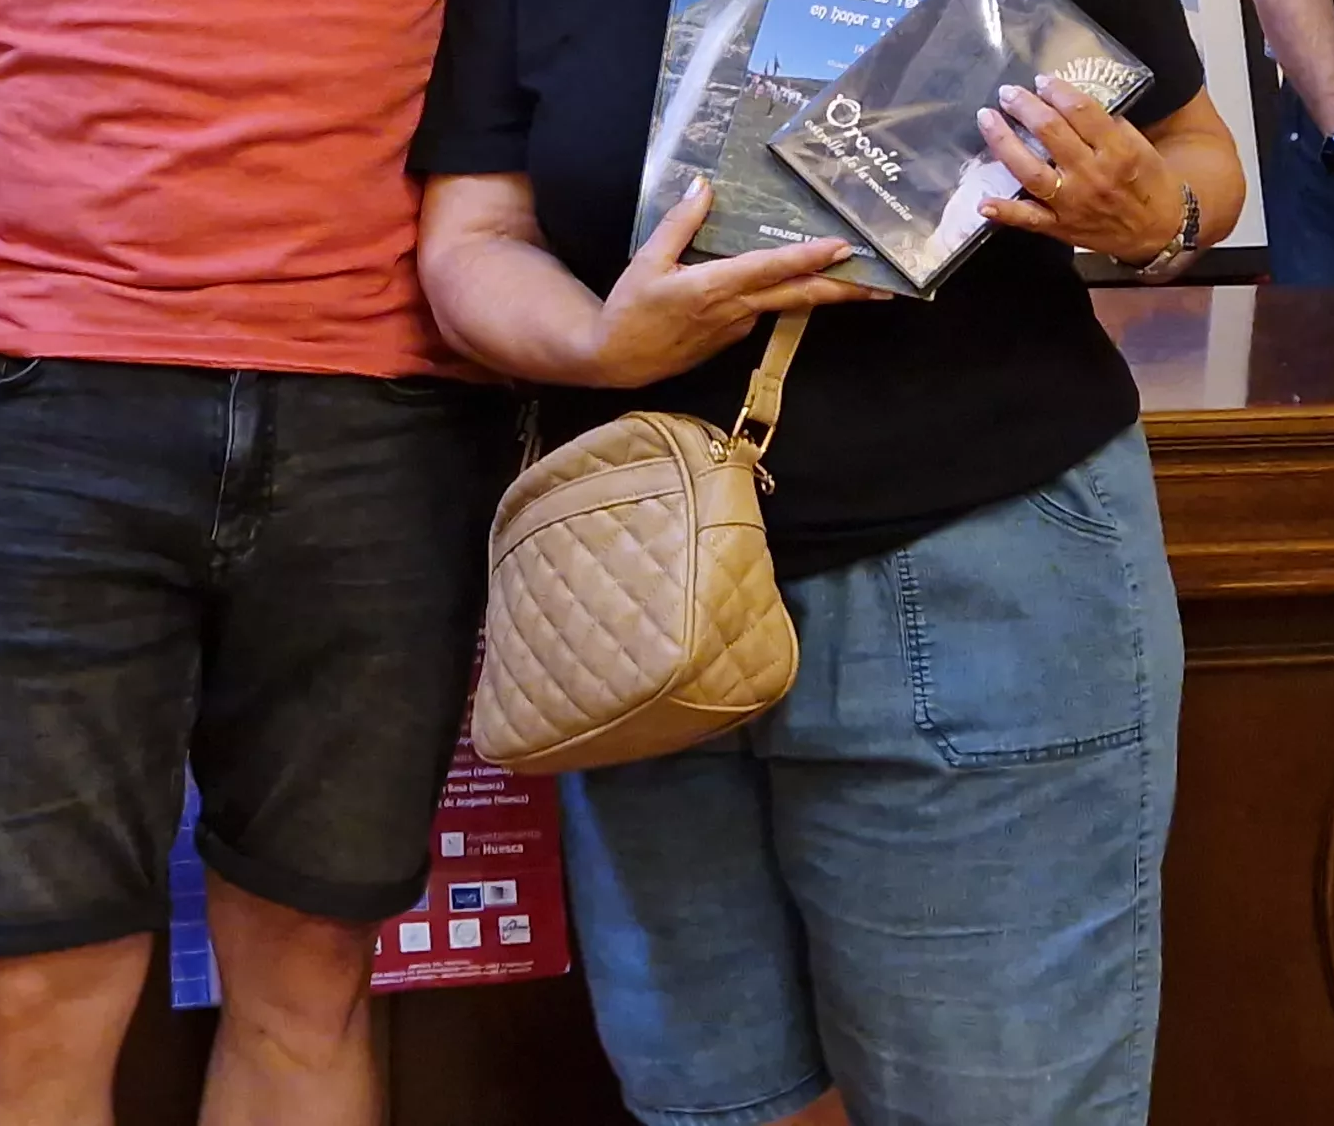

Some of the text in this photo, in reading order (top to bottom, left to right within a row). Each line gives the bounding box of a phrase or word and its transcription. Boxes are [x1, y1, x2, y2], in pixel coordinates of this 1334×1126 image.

[810, 3, 896, 29] en honor a S
[482, 843, 524, 855] Huesca
